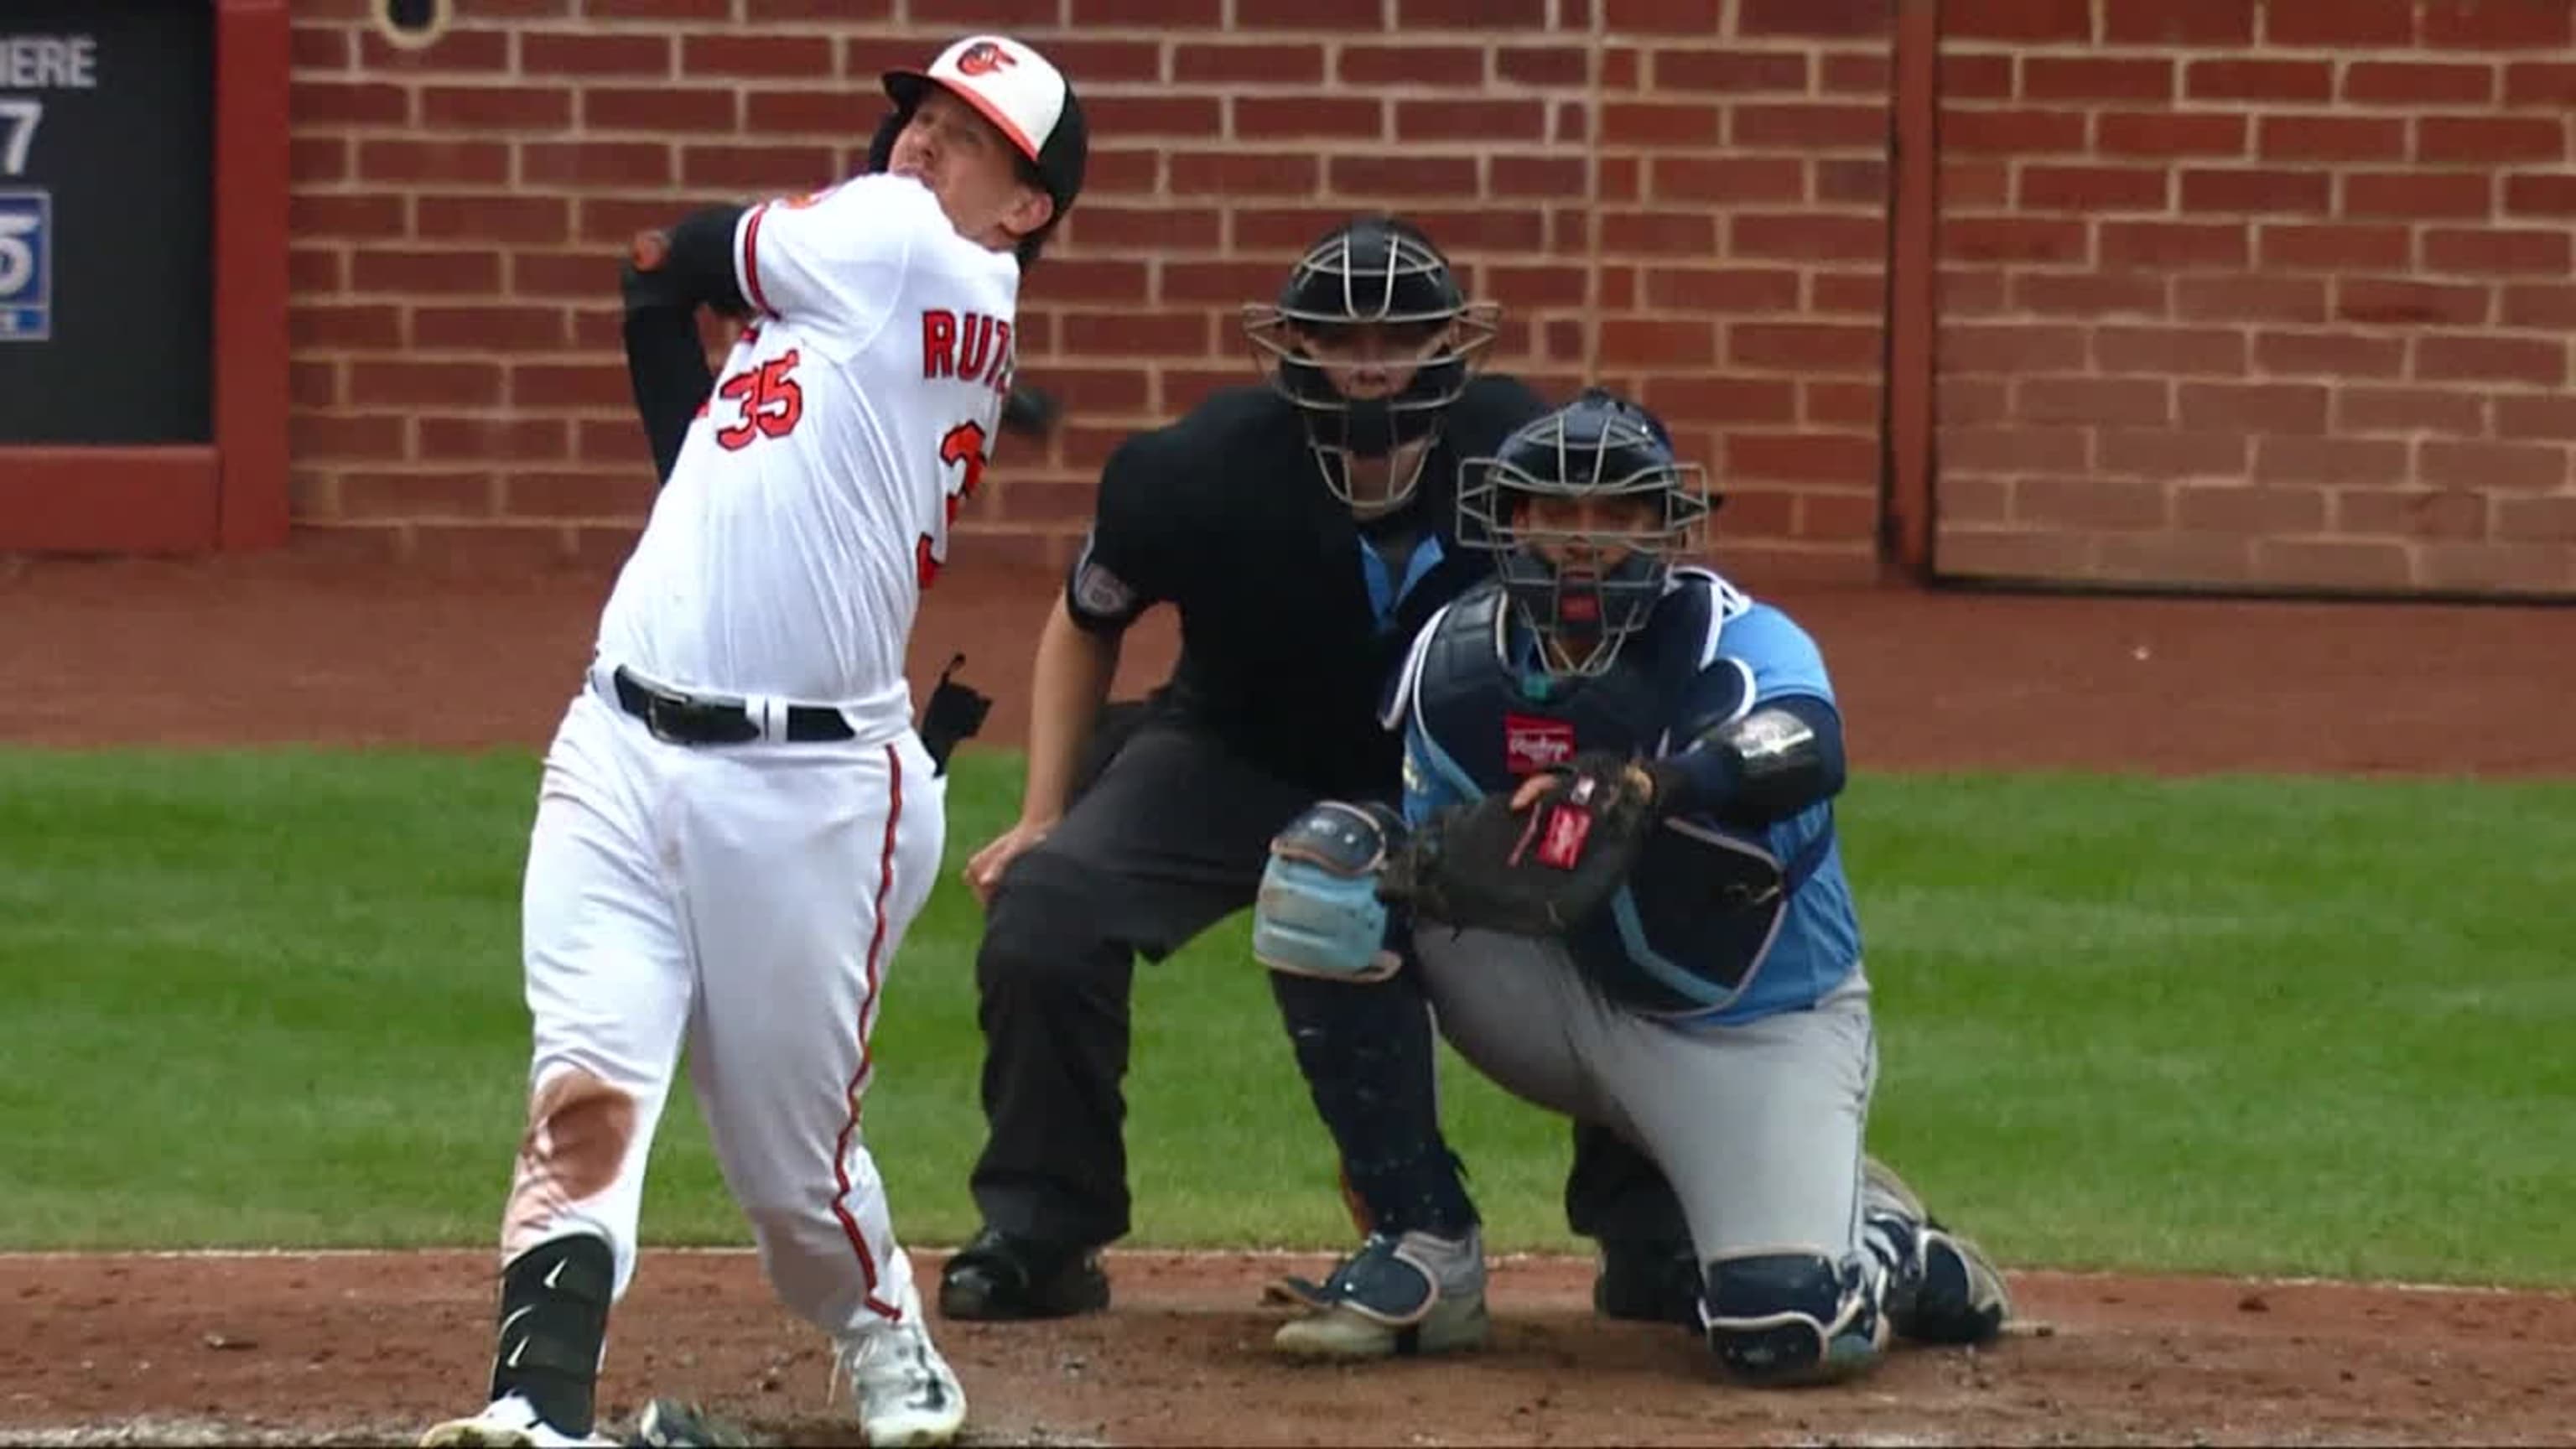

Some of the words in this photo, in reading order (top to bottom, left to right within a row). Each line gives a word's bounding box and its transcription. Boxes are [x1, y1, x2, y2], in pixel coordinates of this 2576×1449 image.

[0, 99, 43, 174] 7
[922, 309, 1009, 394] RUT
[715, 348, 802, 451] 35
